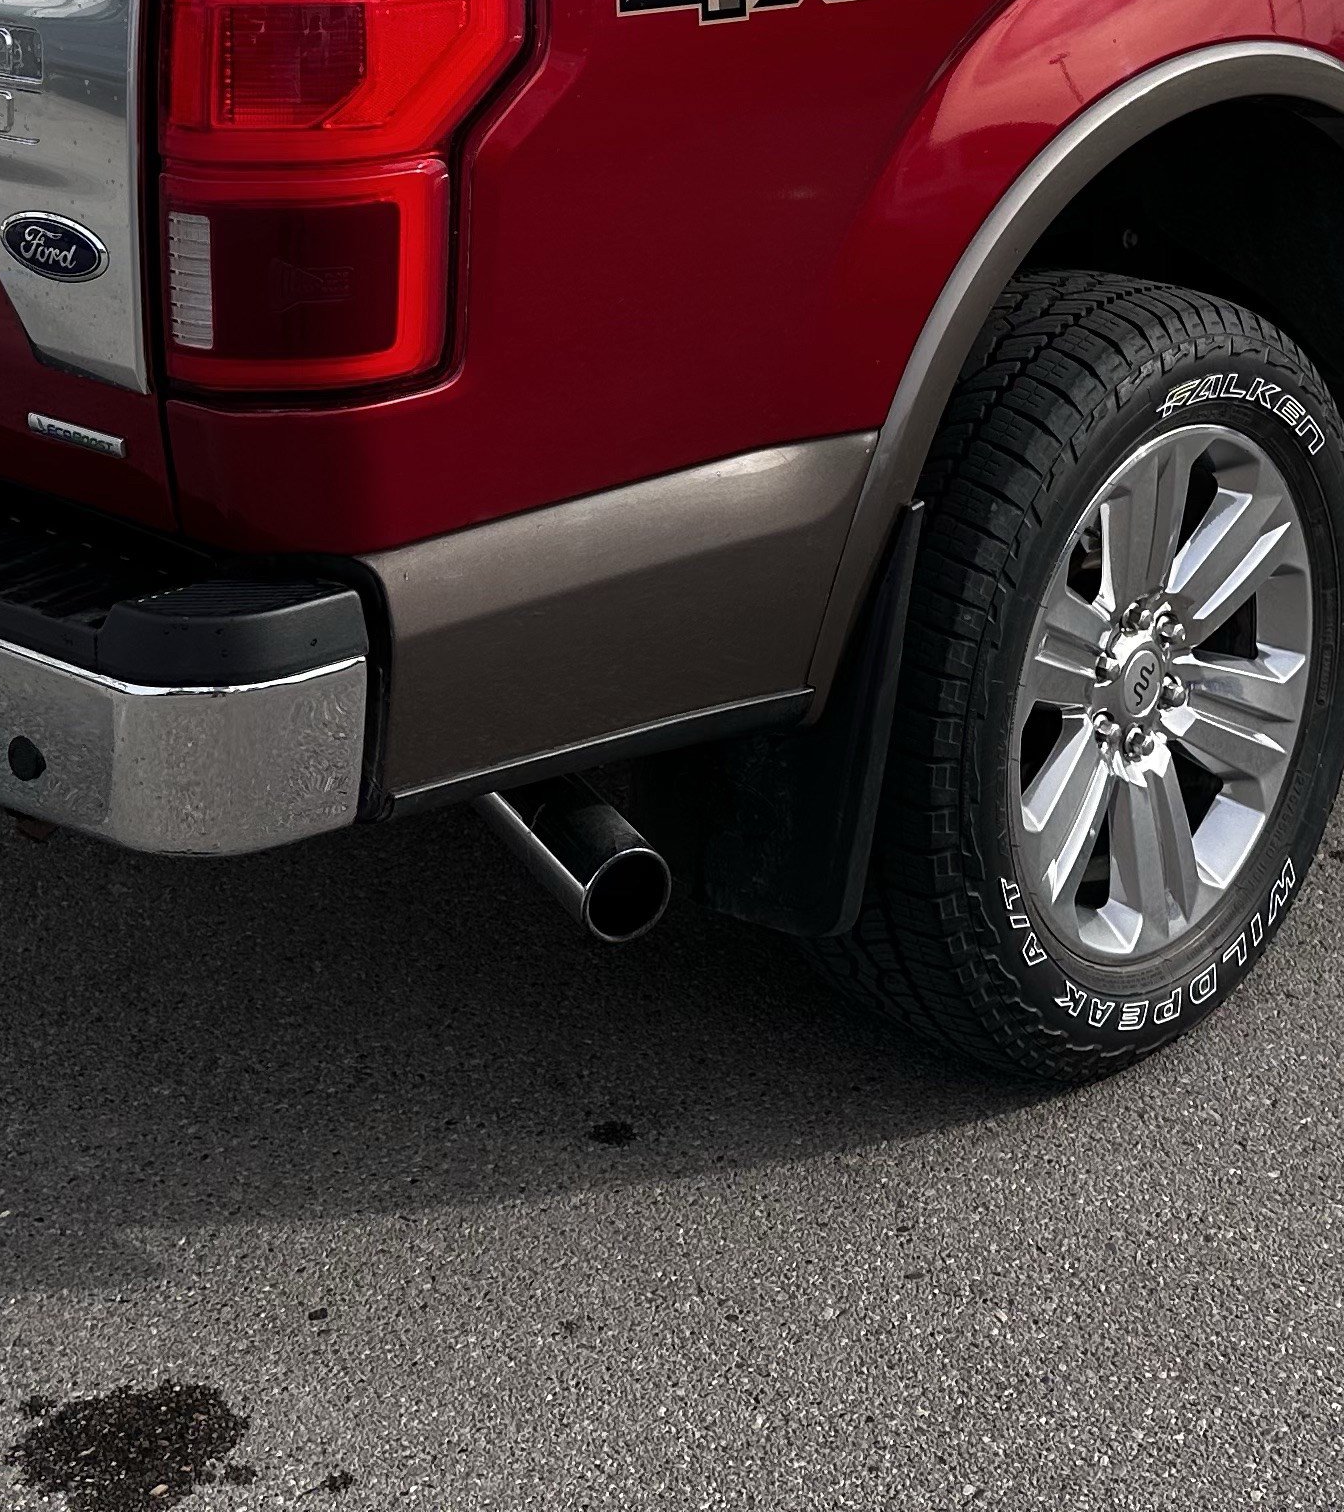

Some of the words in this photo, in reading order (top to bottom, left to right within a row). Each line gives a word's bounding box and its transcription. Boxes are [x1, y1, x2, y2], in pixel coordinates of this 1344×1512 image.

[20, 225, 77, 269] Ford
[1155, 372, 1327, 456] FALKEN
[1054, 856, 1297, 1031] WILDPEAK
